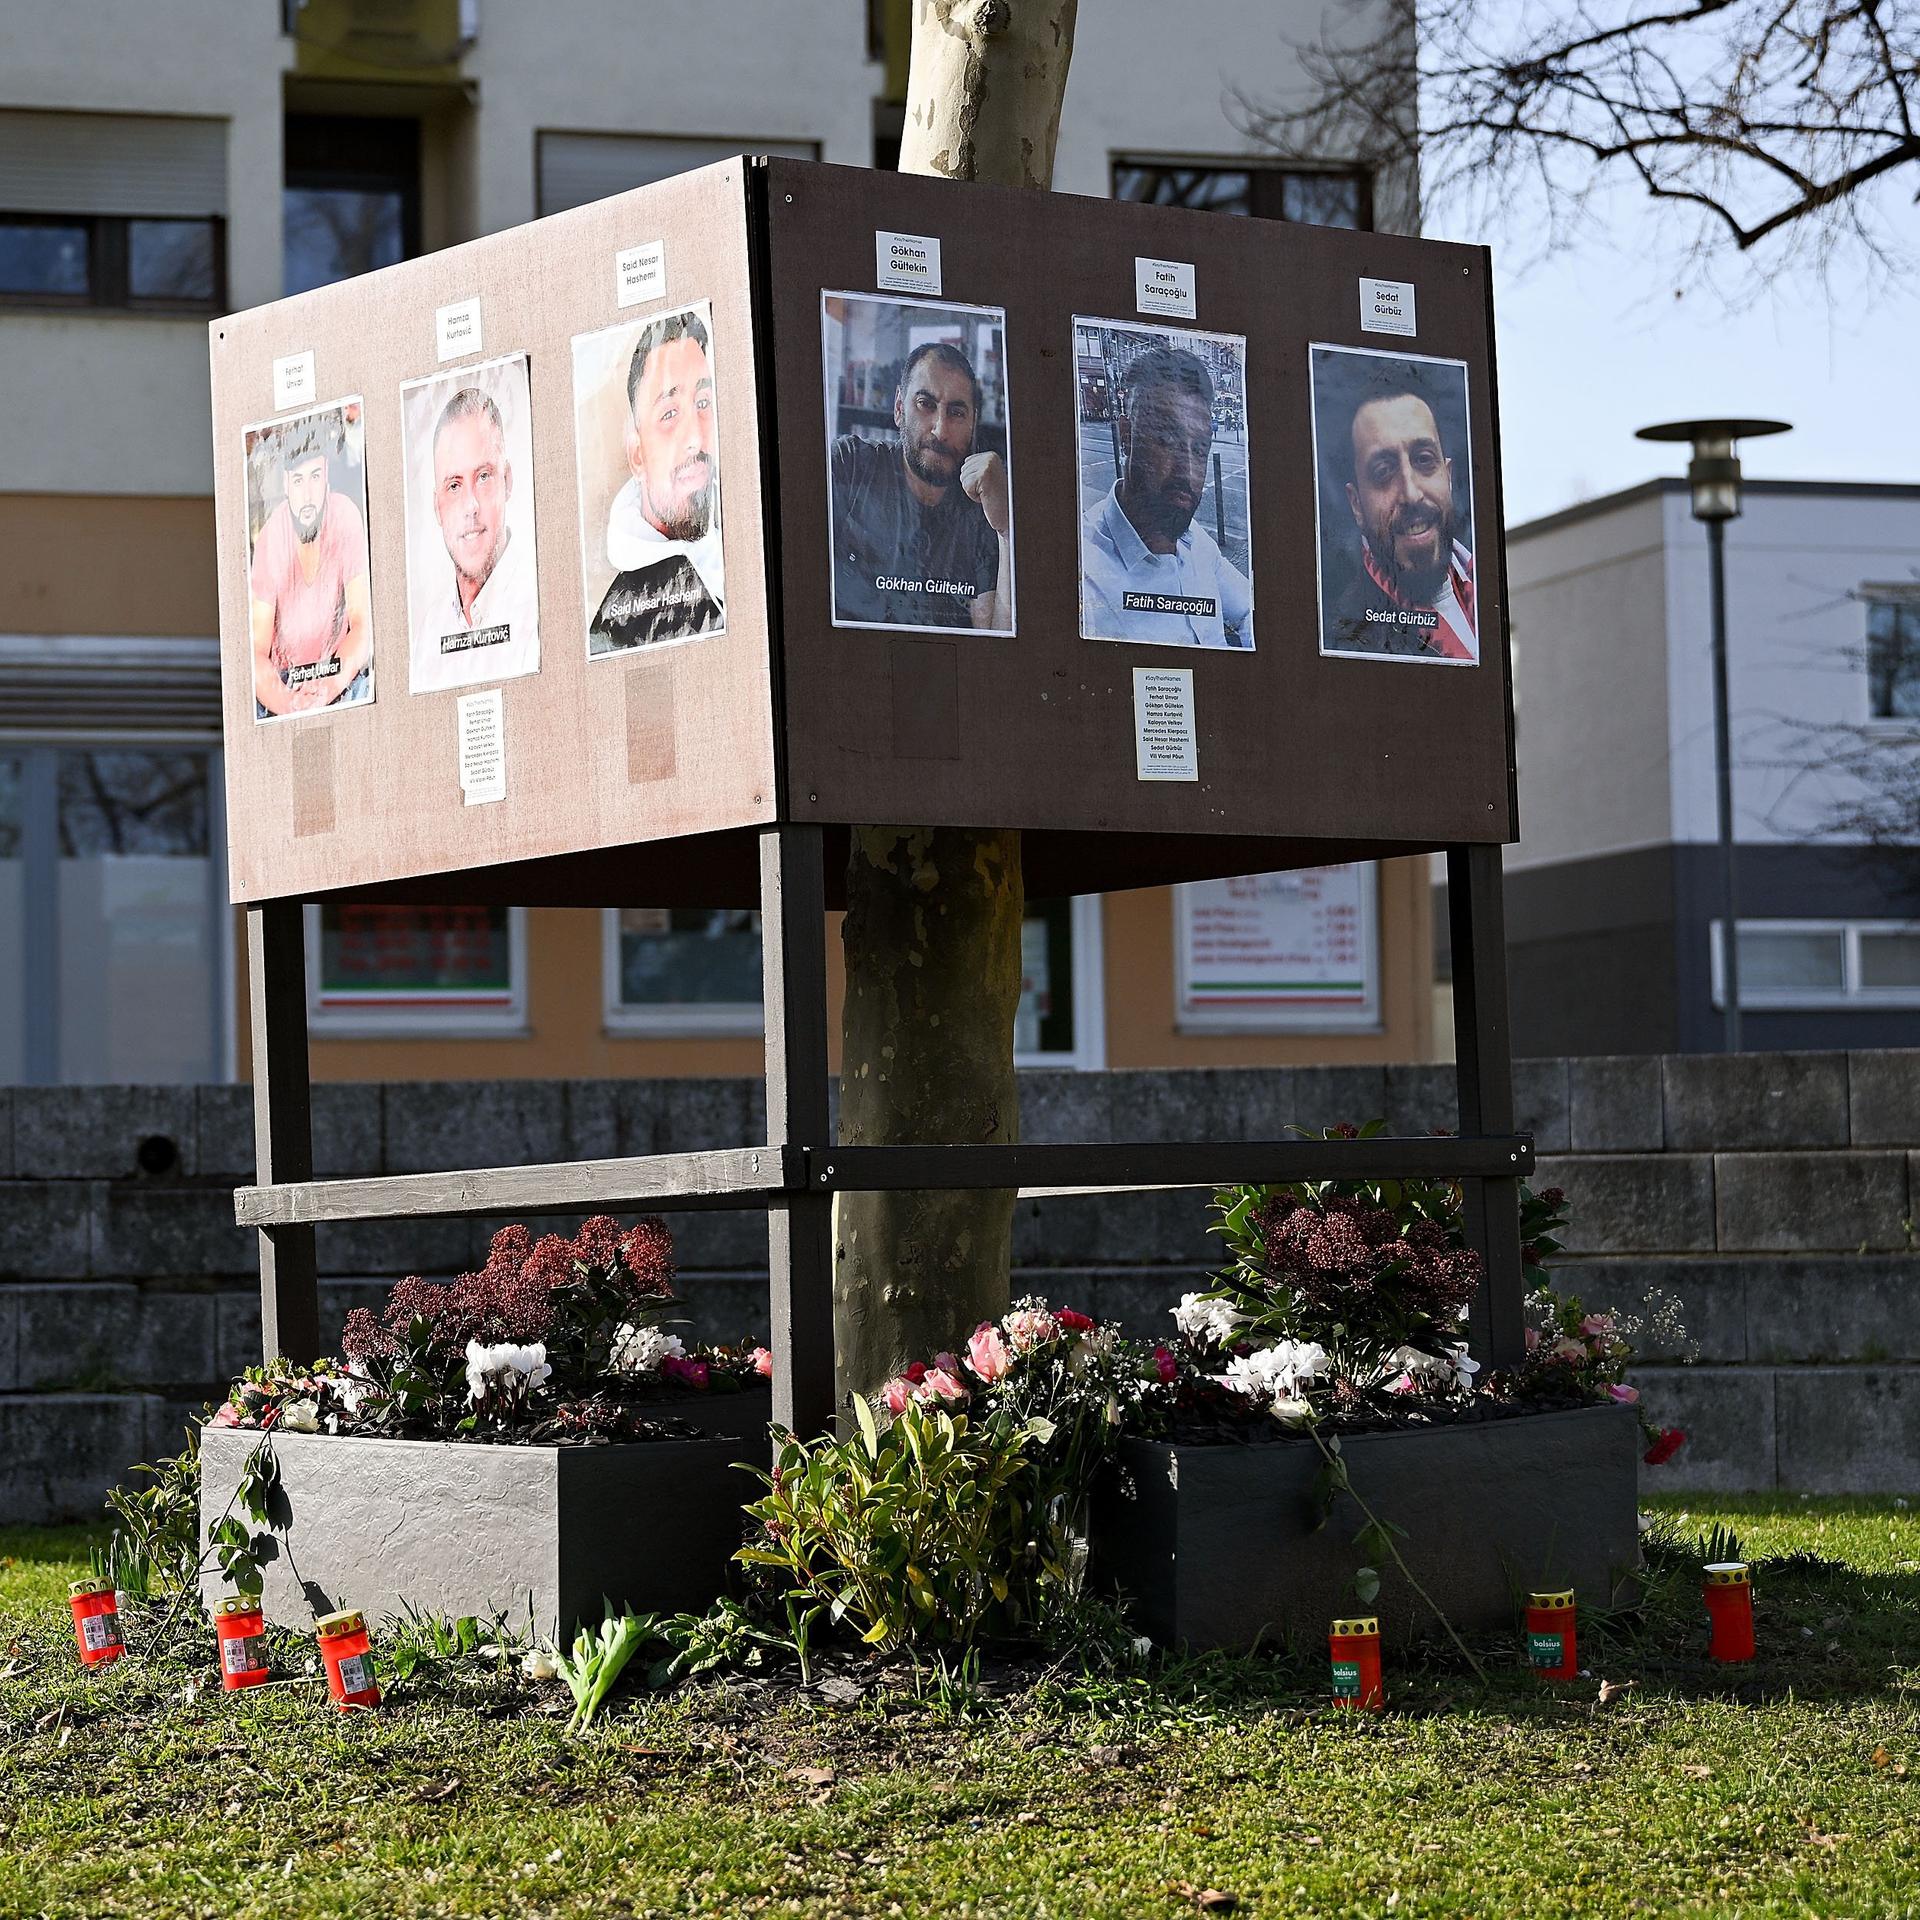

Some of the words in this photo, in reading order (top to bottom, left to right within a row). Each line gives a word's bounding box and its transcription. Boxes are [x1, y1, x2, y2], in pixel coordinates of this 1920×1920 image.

[891, 245, 926, 258] Gökhan
[622, 260, 638, 272] Said
[639, 256, 659, 267] Nesar
[890, 260, 927, 273] Gültekin
[626, 269, 656, 285] Hashemi
[1155, 271, 1176, 282] Fatih
[1144, 284, 1187, 299] Saraçoğlu
[1376, 291, 1399, 302] Sedat
[1374, 304, 1402, 316] Gürbüz
[875, 576, 922, 592] Gökhan
[925, 579, 975, 596] Gültekin
[610, 600, 632, 617] Said
[633, 597, 661, 612] Nesar
[661, 585, 702, 607] Hashemi
[1126, 594, 1154, 609] Fatih
[1156, 596, 1213, 615] Saraçoğlu
[1365, 609, 1397, 623] Sedat
[1398, 611, 1436, 626] Gürbüz
[442, 637, 472, 651] Hamza
[473, 626, 508, 645] Kurtović
[1533, 1639, 1560, 1648] bolsius
[1333, 1667, 1357, 1677] bolsius
